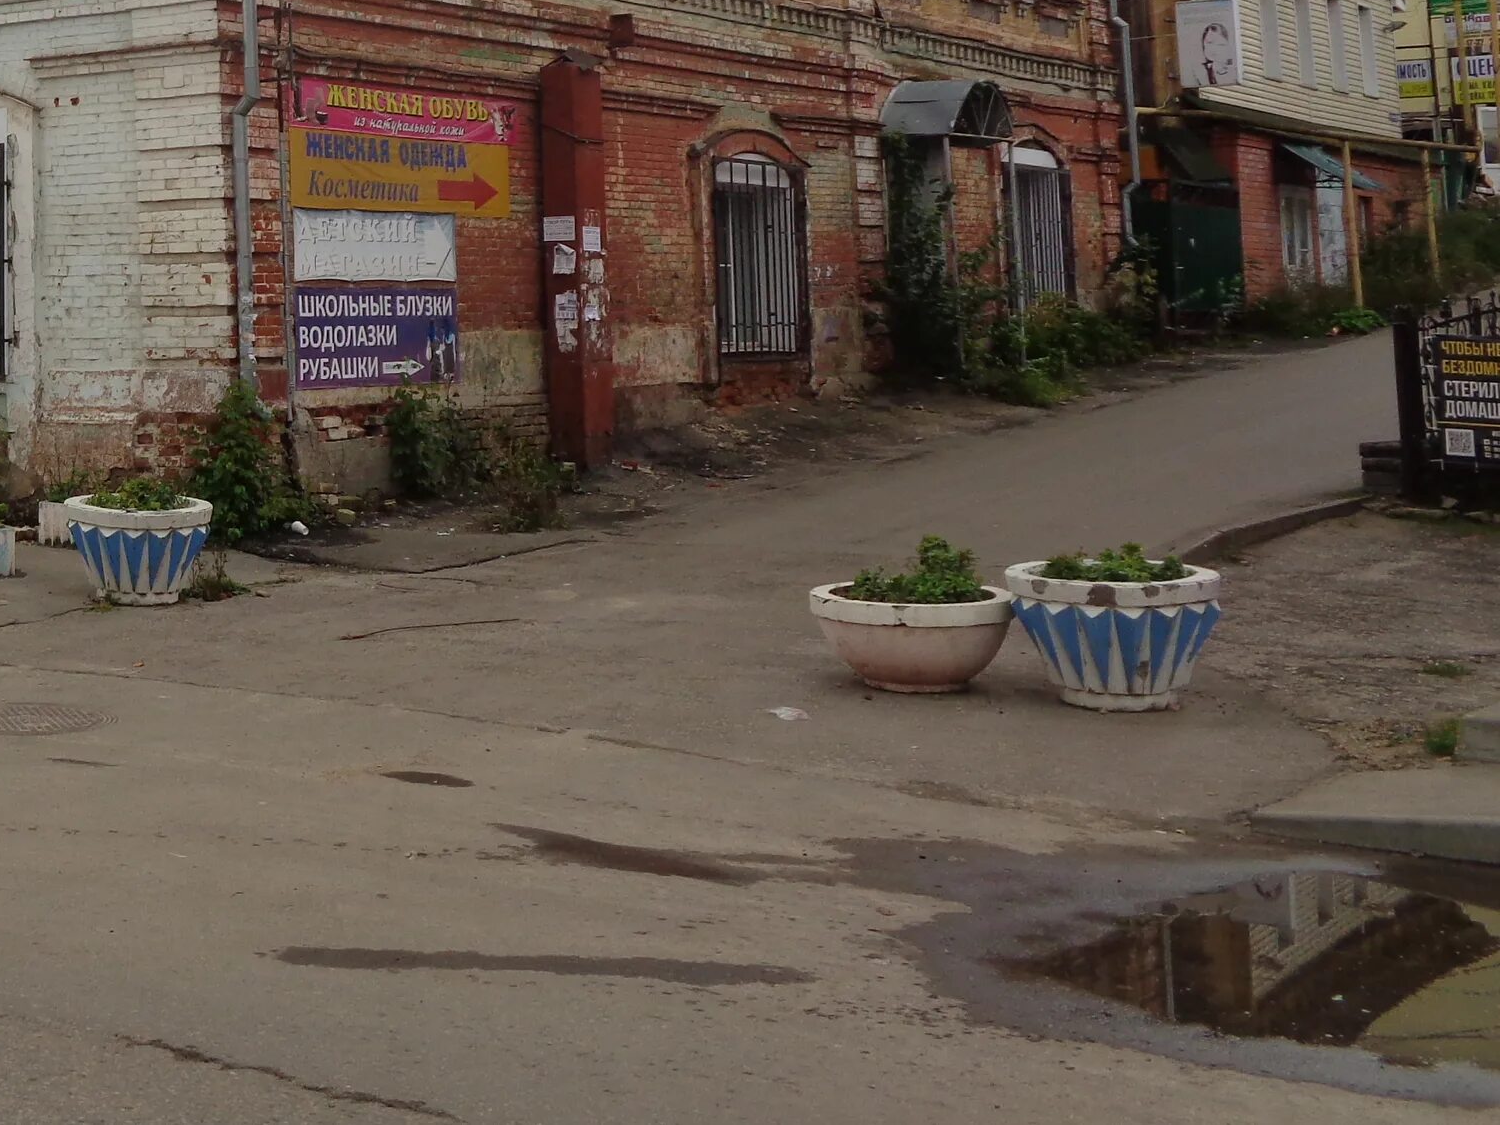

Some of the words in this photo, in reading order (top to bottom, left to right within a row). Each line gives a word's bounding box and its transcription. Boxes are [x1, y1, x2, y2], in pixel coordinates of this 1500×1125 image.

[327, 83, 424, 117] ЖЕНСКАЯ
[428, 96, 490, 122] ОБУВЬ
[354, 115, 366, 127] из
[369, 118, 437, 136] натуральной
[439, 125, 465, 137] кожи
[306, 131, 391, 164] ЖЕНСКАЯ
[399, 142, 468, 173] ОДЕЖДА
[307, 170, 420, 203] Косметика
[298, 214, 421, 244] ДЕТСКИЙ
[298, 295, 393, 318] ШКОЛЬНЫЕ
[396, 295, 453, 316] БЛУЗКИ
[300, 325, 398, 353] ВОДОЛАЗКИ
[1441, 340, 1484, 356] ЧТОБЫ
[300, 357, 379, 381] РУБАШКИ
